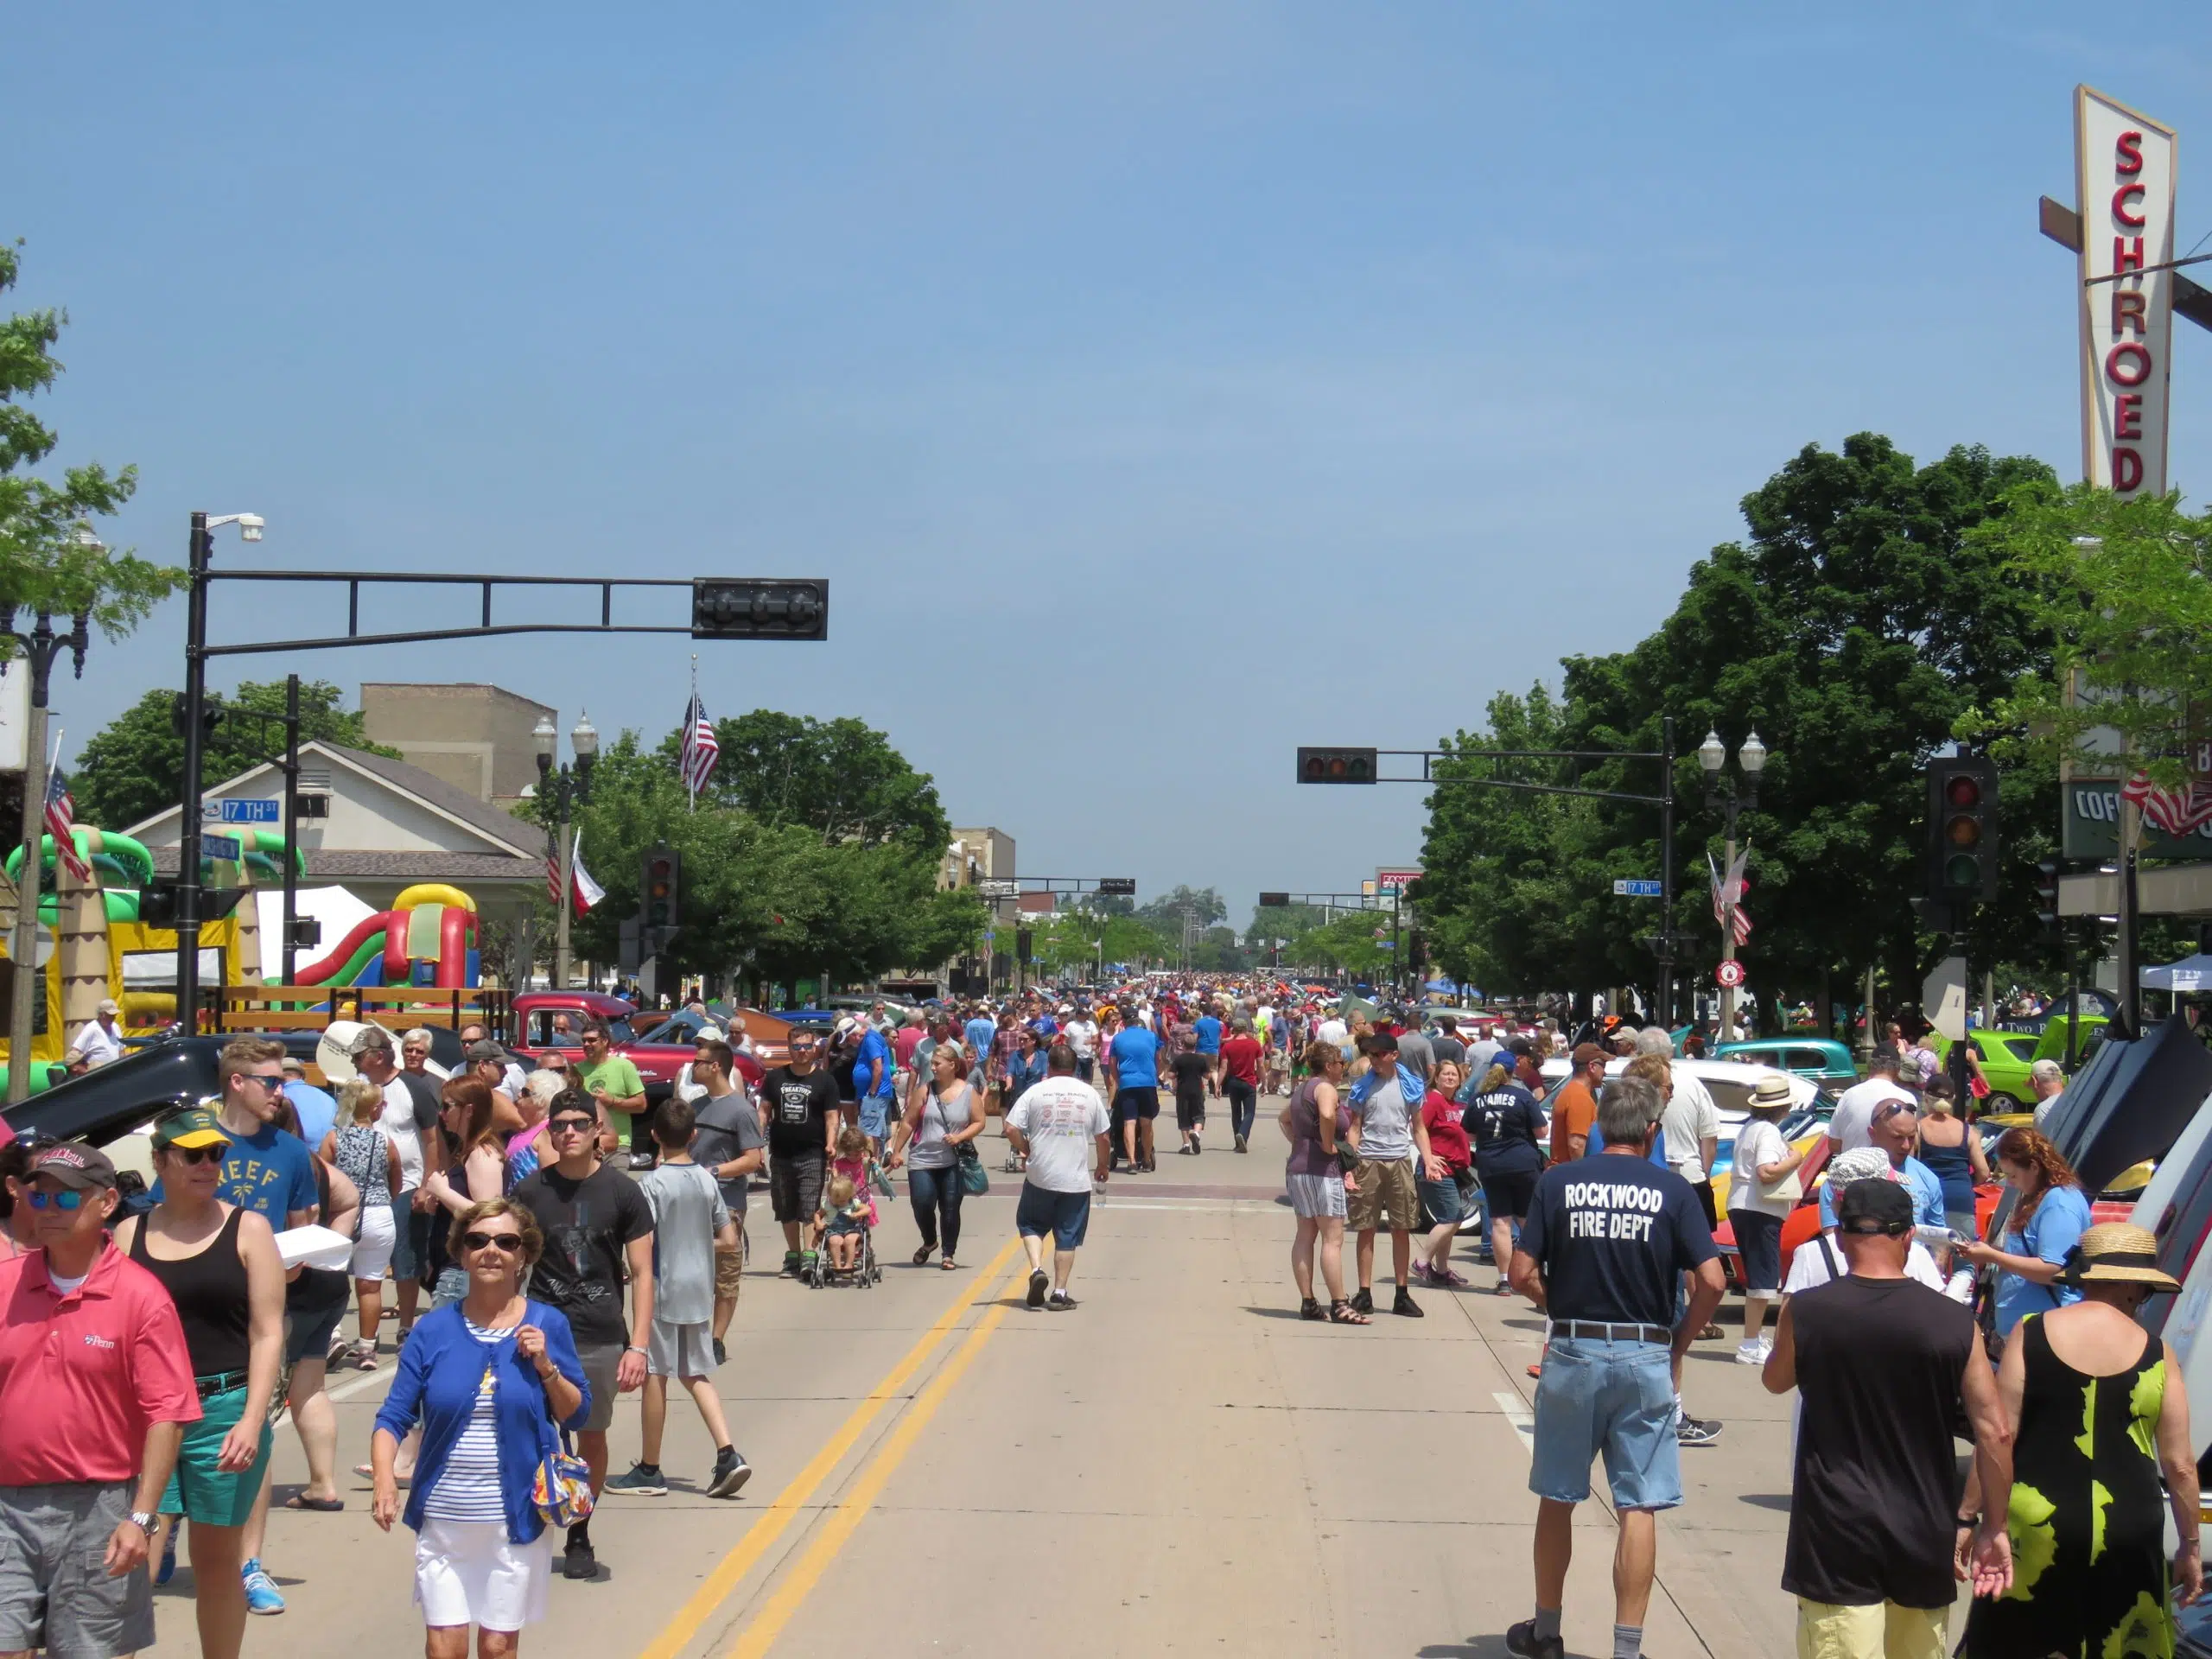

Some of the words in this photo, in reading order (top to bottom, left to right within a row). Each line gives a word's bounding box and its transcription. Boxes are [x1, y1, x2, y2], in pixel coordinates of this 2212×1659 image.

[225, 802, 239, 820] 17
[245, 802, 264, 820] TH
[266, 802, 276, 811] ST
[1628, 882, 1637, 893] 17
[1640, 882, 1651, 893] TH
[1485, 1110, 1504, 1138] 7
[1565, 1182, 1662, 1213] ROCKWOOD
[1570, 1211, 1605, 1238] FIRE
[1609, 1212, 1653, 1242] DEPT
